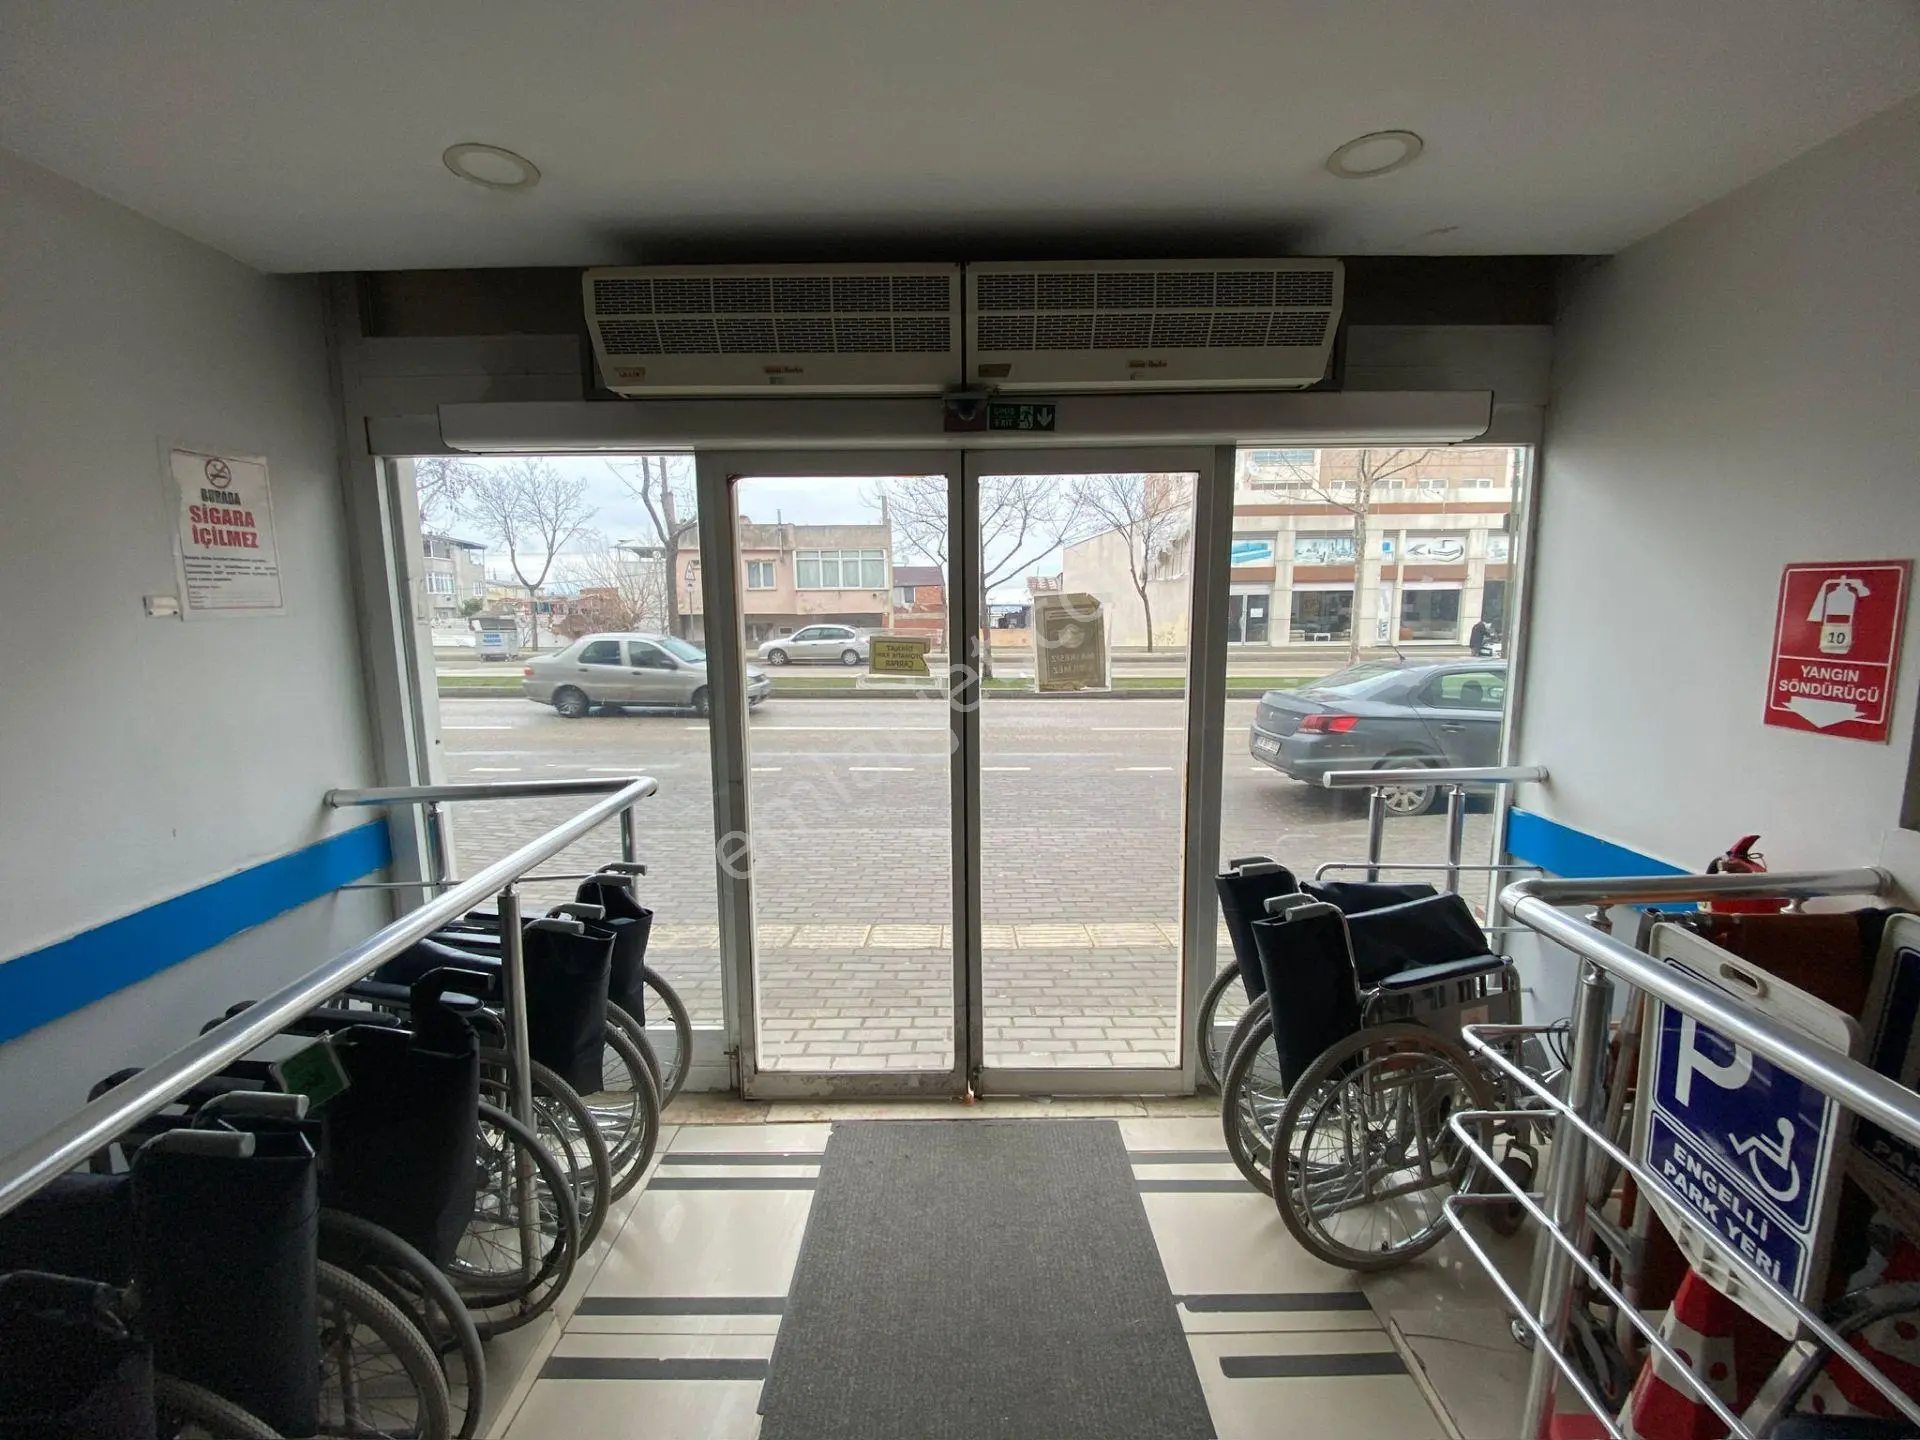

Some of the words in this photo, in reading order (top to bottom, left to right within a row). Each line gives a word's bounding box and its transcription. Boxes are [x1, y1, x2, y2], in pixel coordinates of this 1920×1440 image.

[200, 487, 242, 506] BURADA
[189, 504, 256, 528] SİGARA
[192, 523, 259, 549] İÇİLMEZ
[1827, 632, 1846, 645] 10
[1801, 664, 1860, 683] YANGIN
[1778, 679, 1880, 703] SÖNDÜRÜCÜ
[1674, 1012, 1753, 1107] P
[1673, 1142, 1769, 1242] ENGELLİ
[1664, 1158, 1720, 1225] PARK
[1725, 1215, 1781, 1283] YERİ
